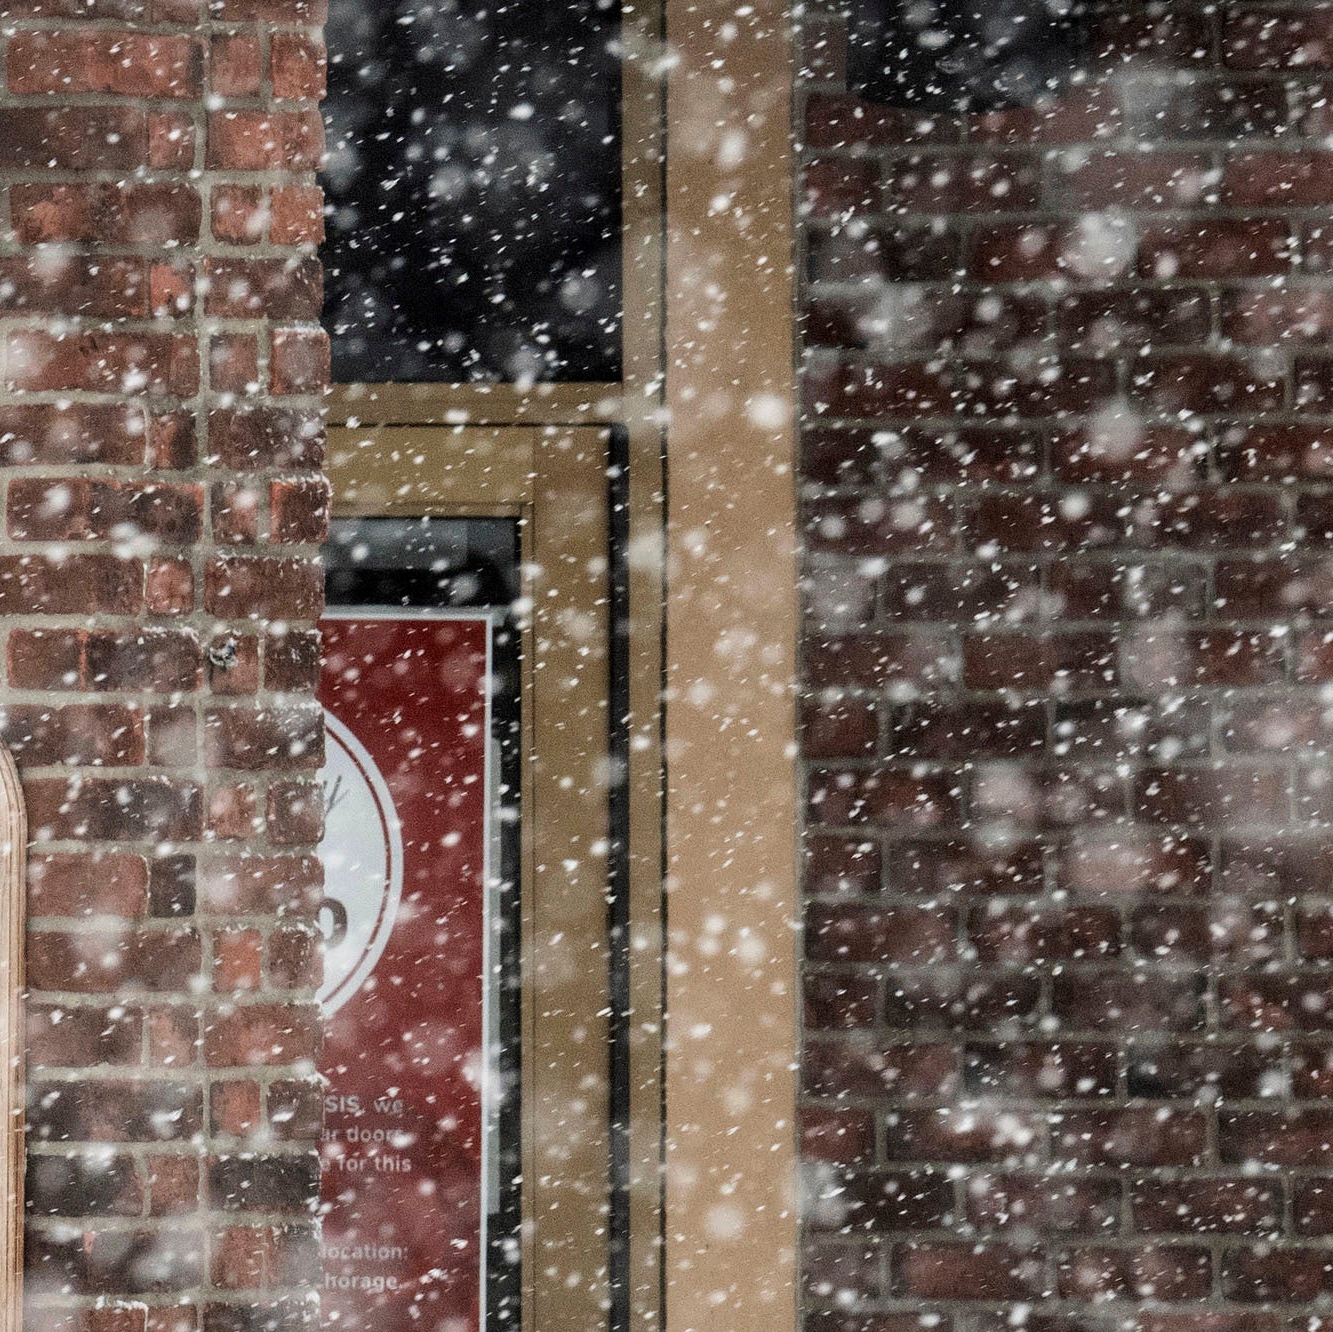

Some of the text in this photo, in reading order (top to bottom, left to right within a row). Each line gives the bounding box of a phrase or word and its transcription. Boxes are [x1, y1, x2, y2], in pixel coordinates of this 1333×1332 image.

[324, 1094, 404, 1113] SIS we
[337, 1154, 366, 1172] for
[374, 1154, 412, 1172] this
[324, 1272, 398, 1293] horage
